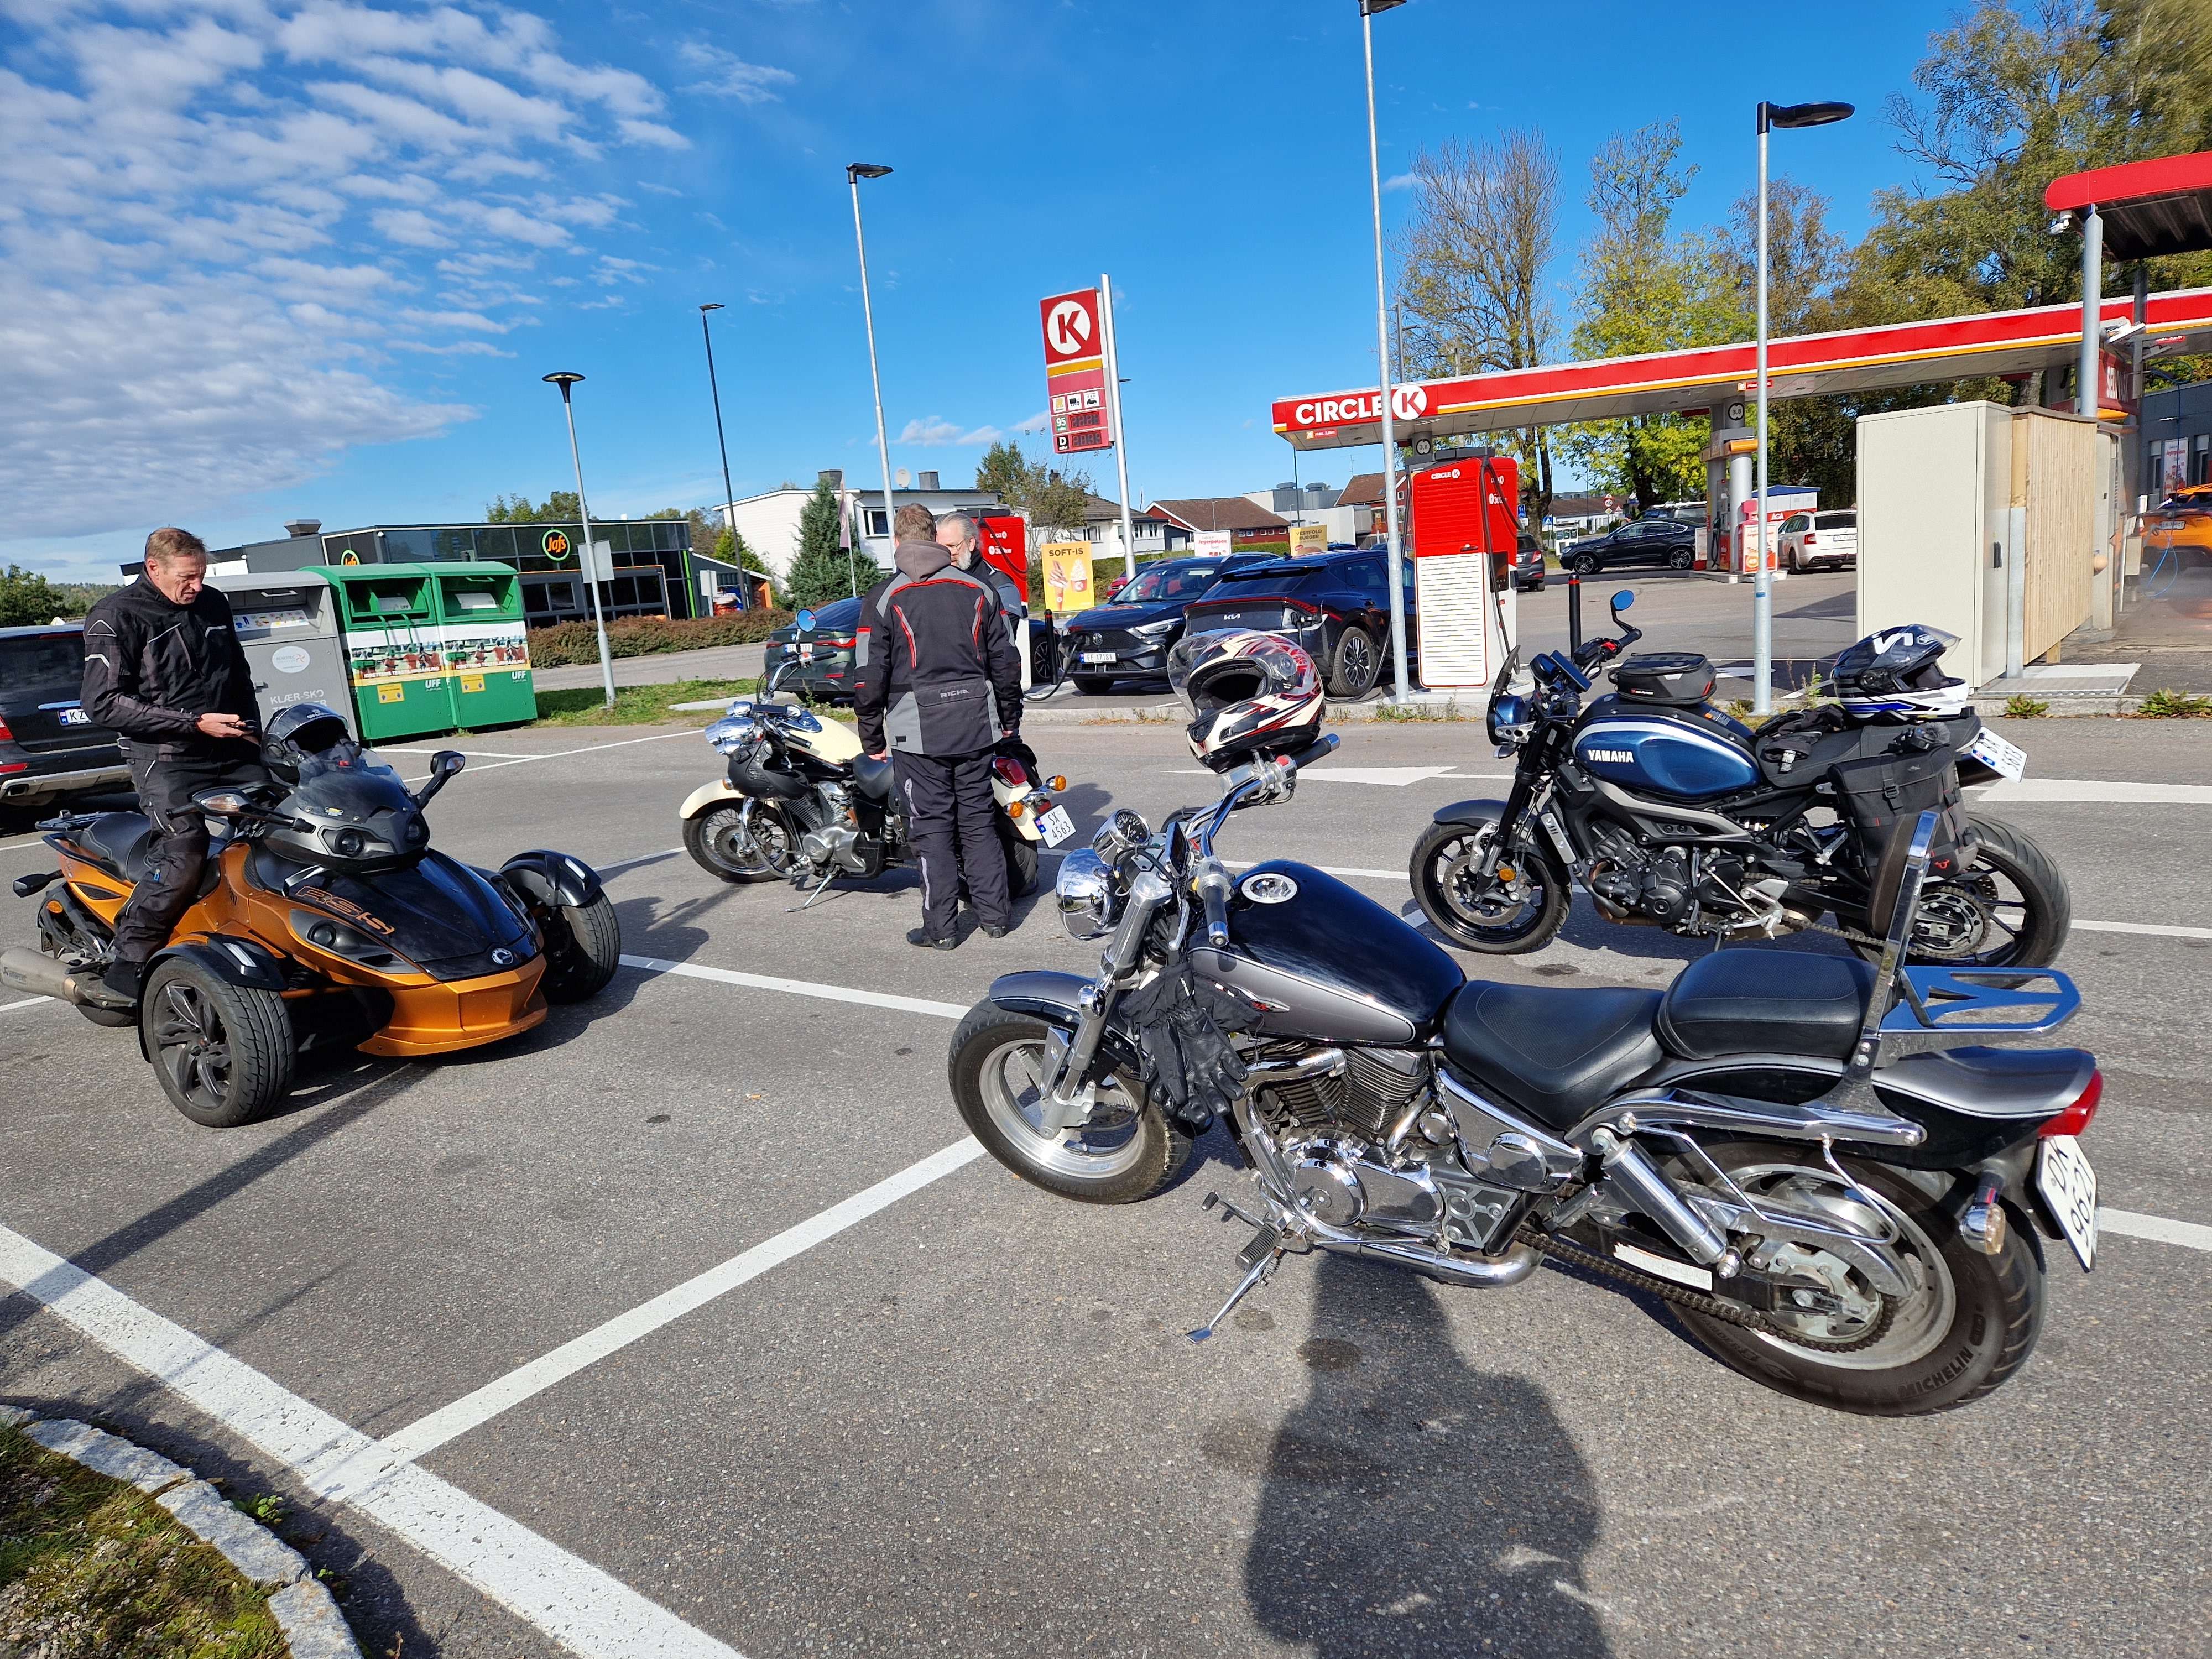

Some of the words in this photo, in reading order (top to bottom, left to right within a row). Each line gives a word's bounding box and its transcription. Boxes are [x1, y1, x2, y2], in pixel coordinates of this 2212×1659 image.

[1296, 395, 1383, 424] CIRCLE
[1056, 416, 1066, 427] 95
[1058, 436, 1067, 446] D
[547, 535, 566, 553] Jafs
[1049, 548, 1083, 557] SOFT-IS
[512, 670, 526, 680] UFF
[425, 679, 441, 688] UFF
[270, 689, 324, 705] KLÆR-SKO
[940, 689, 969, 698] RICHA
[69, 711, 86, 721] KZ
[1588, 749, 1634, 763] YAMAHA
[1048, 811, 1060, 826] SX
[1052, 821, 1071, 839] 4563
[2047, 1135, 2069, 1195] DK
[2070, 1154, 2093, 1248] 9621
[1897, 1345, 1974, 1399] MICHELIN
